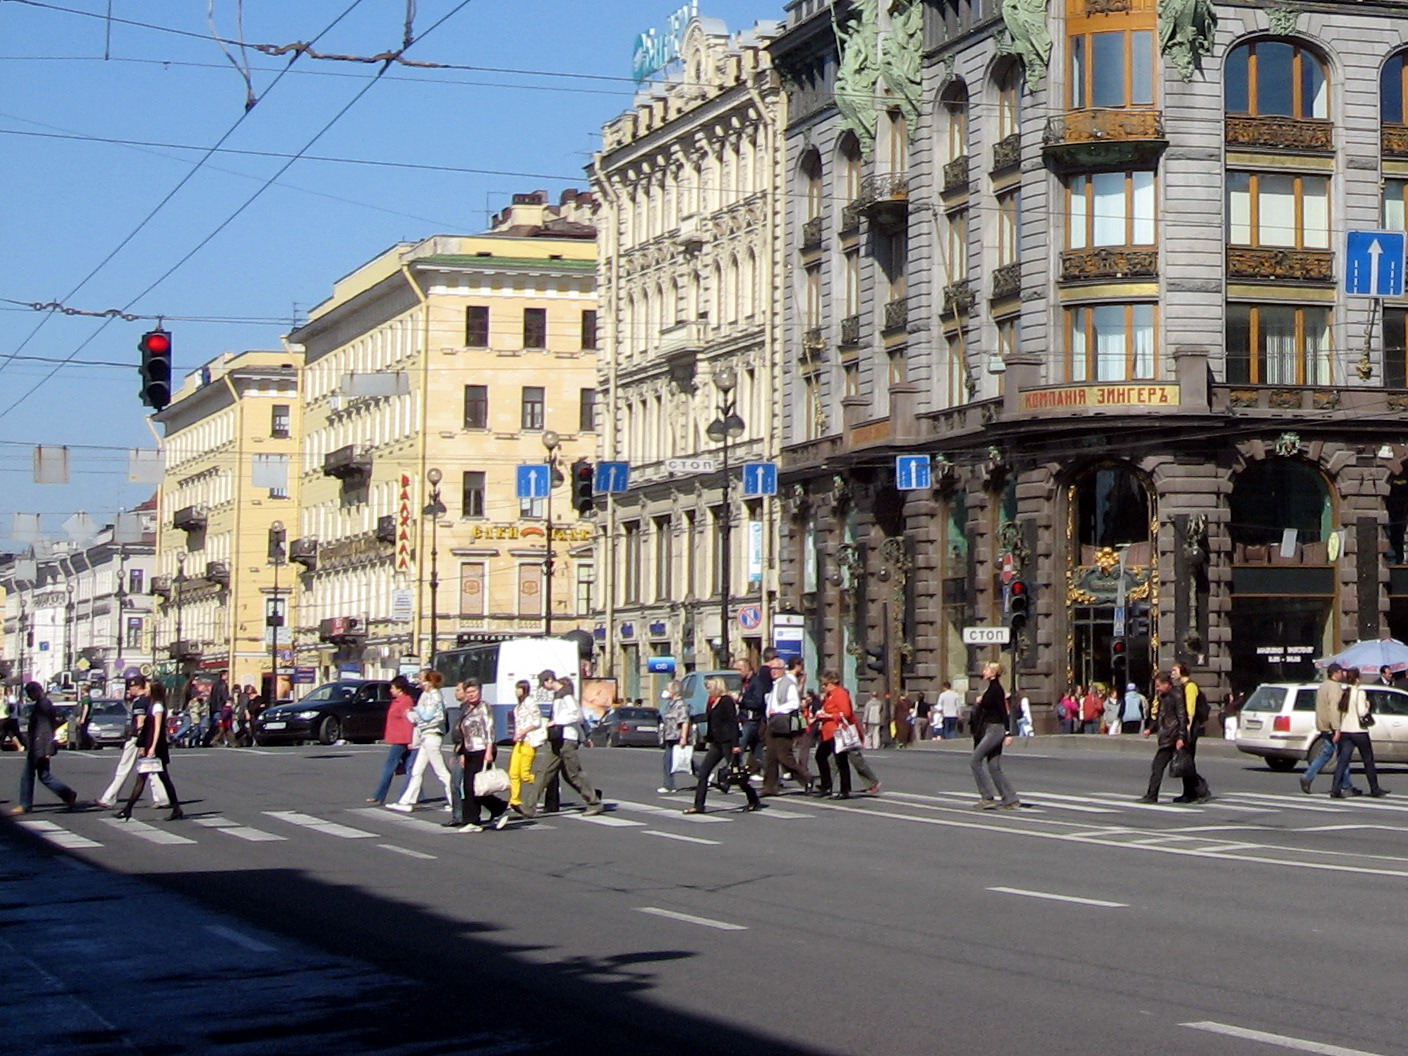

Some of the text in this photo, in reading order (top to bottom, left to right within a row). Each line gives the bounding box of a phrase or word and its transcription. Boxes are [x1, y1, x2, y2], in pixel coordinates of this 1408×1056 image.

[1025, 387, 1168, 408] КОМПАНІЯ ЗИНГЕРЪ
[668, 460, 712, 470] СТОП
[969, 629, 1004, 642] СТОП
